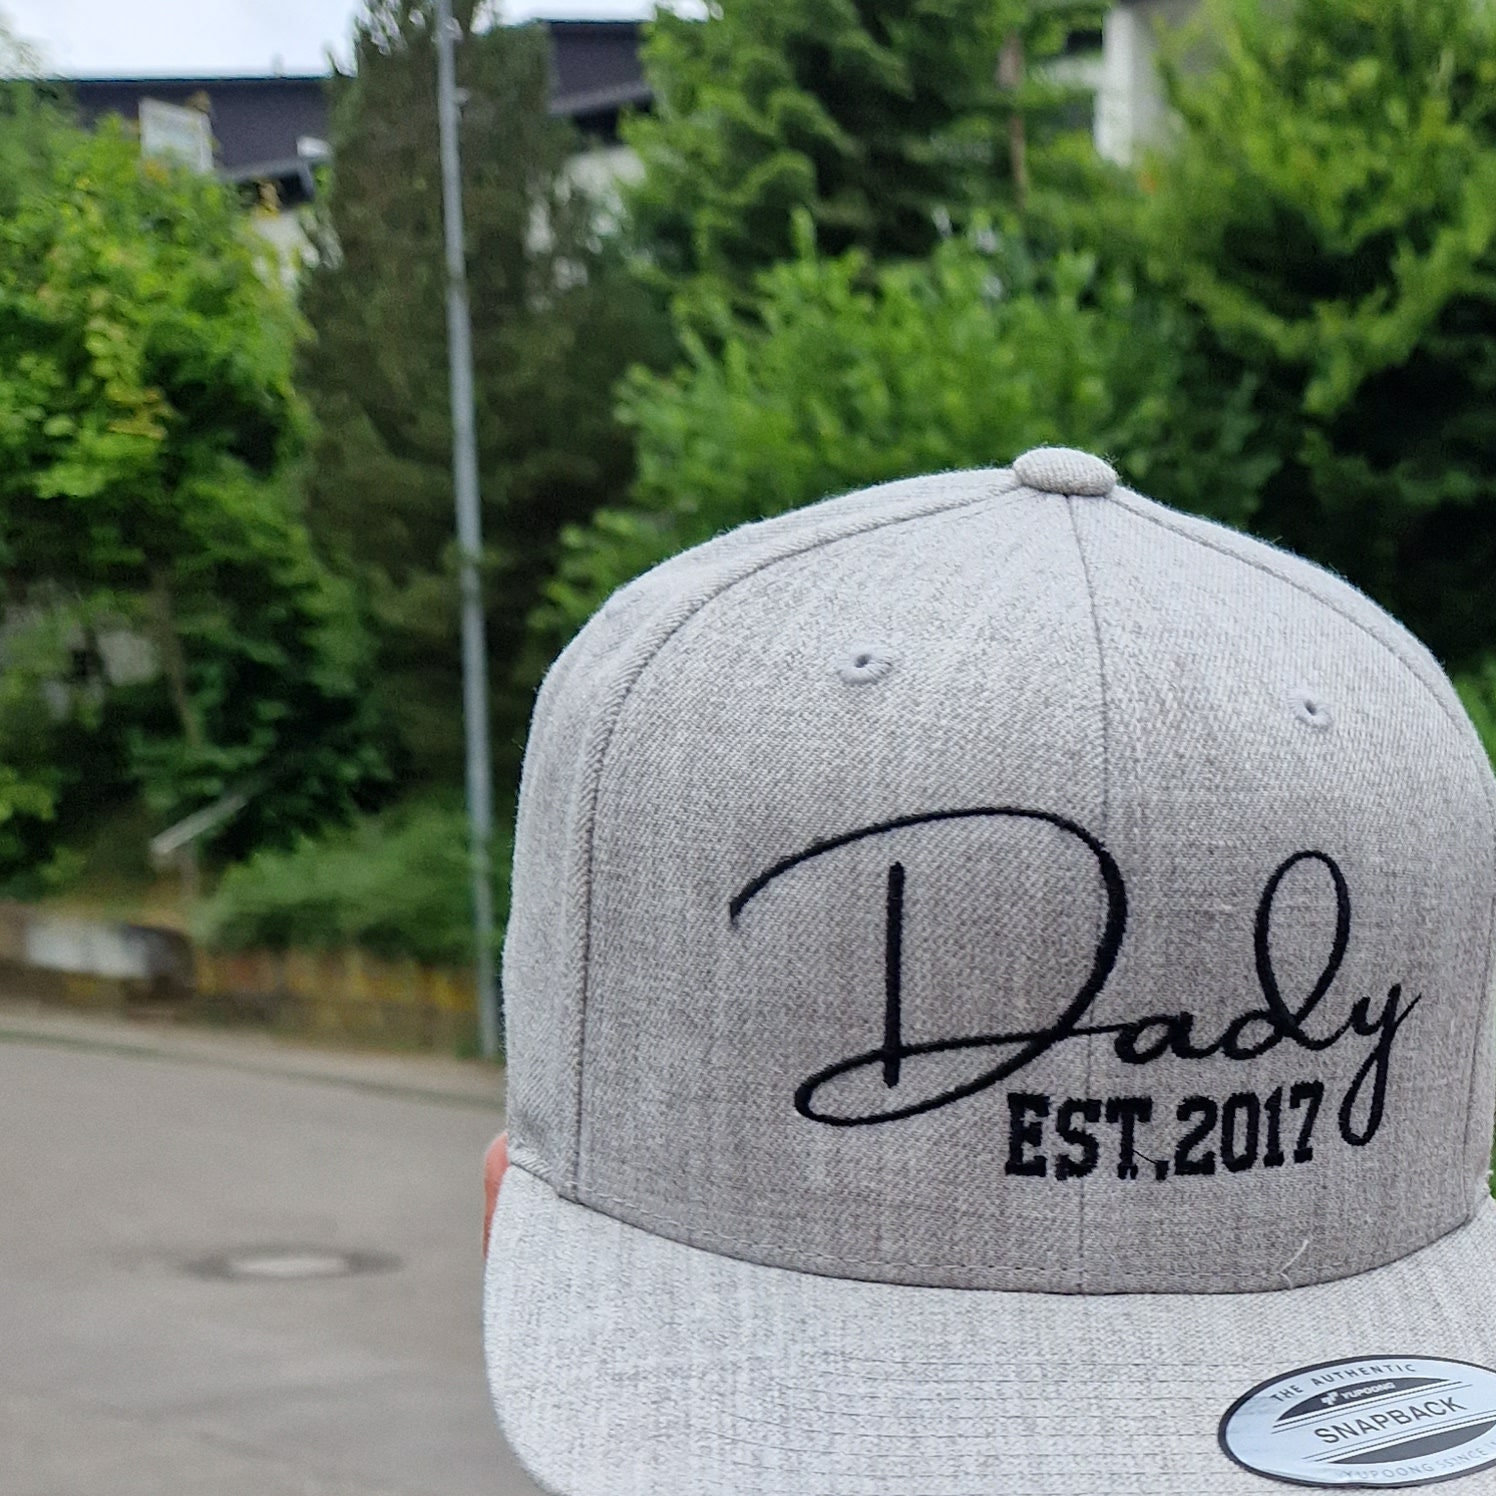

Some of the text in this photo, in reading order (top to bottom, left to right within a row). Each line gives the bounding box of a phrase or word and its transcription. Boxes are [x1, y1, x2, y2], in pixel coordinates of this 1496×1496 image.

[729, 806, 1421, 1147] Dady
[1272, 1364, 1416, 1402] THE AUTHENTIC
[1342, 1381, 1397, 1400] YUPOONG
[1313, 1396, 1466, 1445] SNAPBACK
